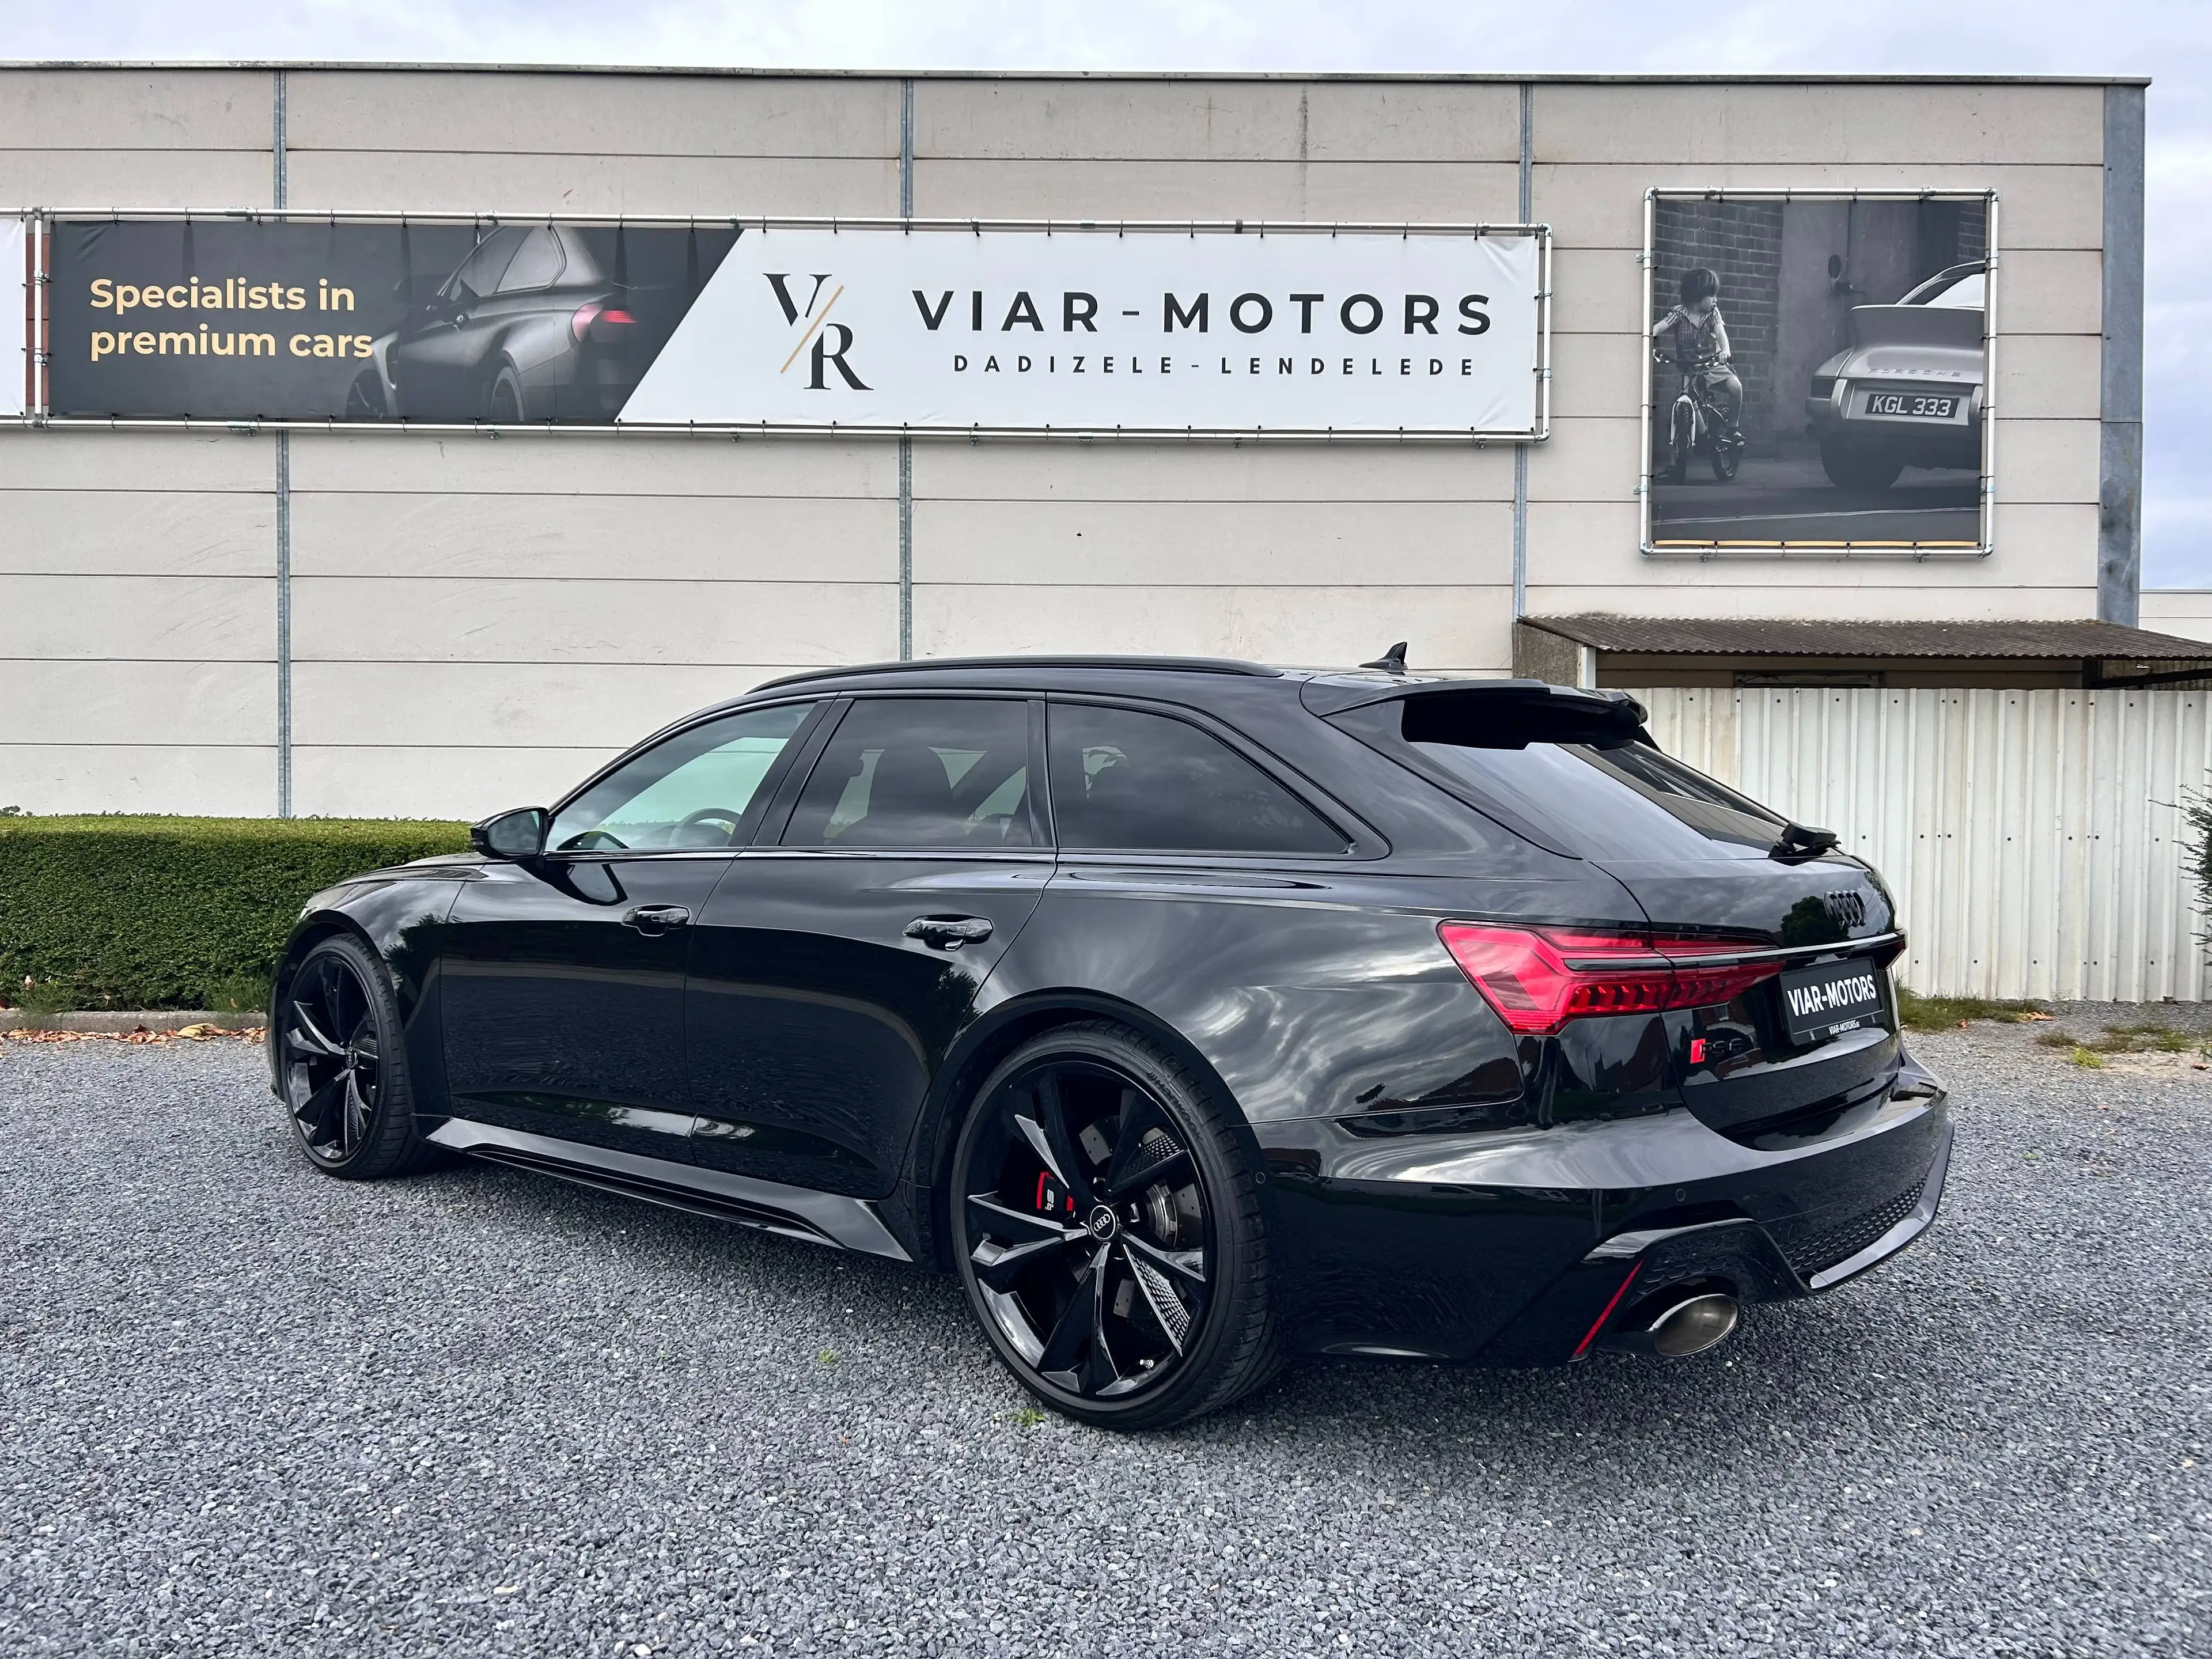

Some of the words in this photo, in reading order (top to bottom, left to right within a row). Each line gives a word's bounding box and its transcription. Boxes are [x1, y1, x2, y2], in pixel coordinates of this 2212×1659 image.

[90, 276, 305, 315] Specialists
[319, 278, 355, 311] in
[91, 323, 276, 362] premium
[290, 332, 372, 358] cars
[1868, 368, 1961, 378] PORSCHE
[1872, 395, 1908, 414] KGL
[1912, 397, 1952, 417] 333
[1787, 974, 1876, 1017] VIAR-MOTORS
